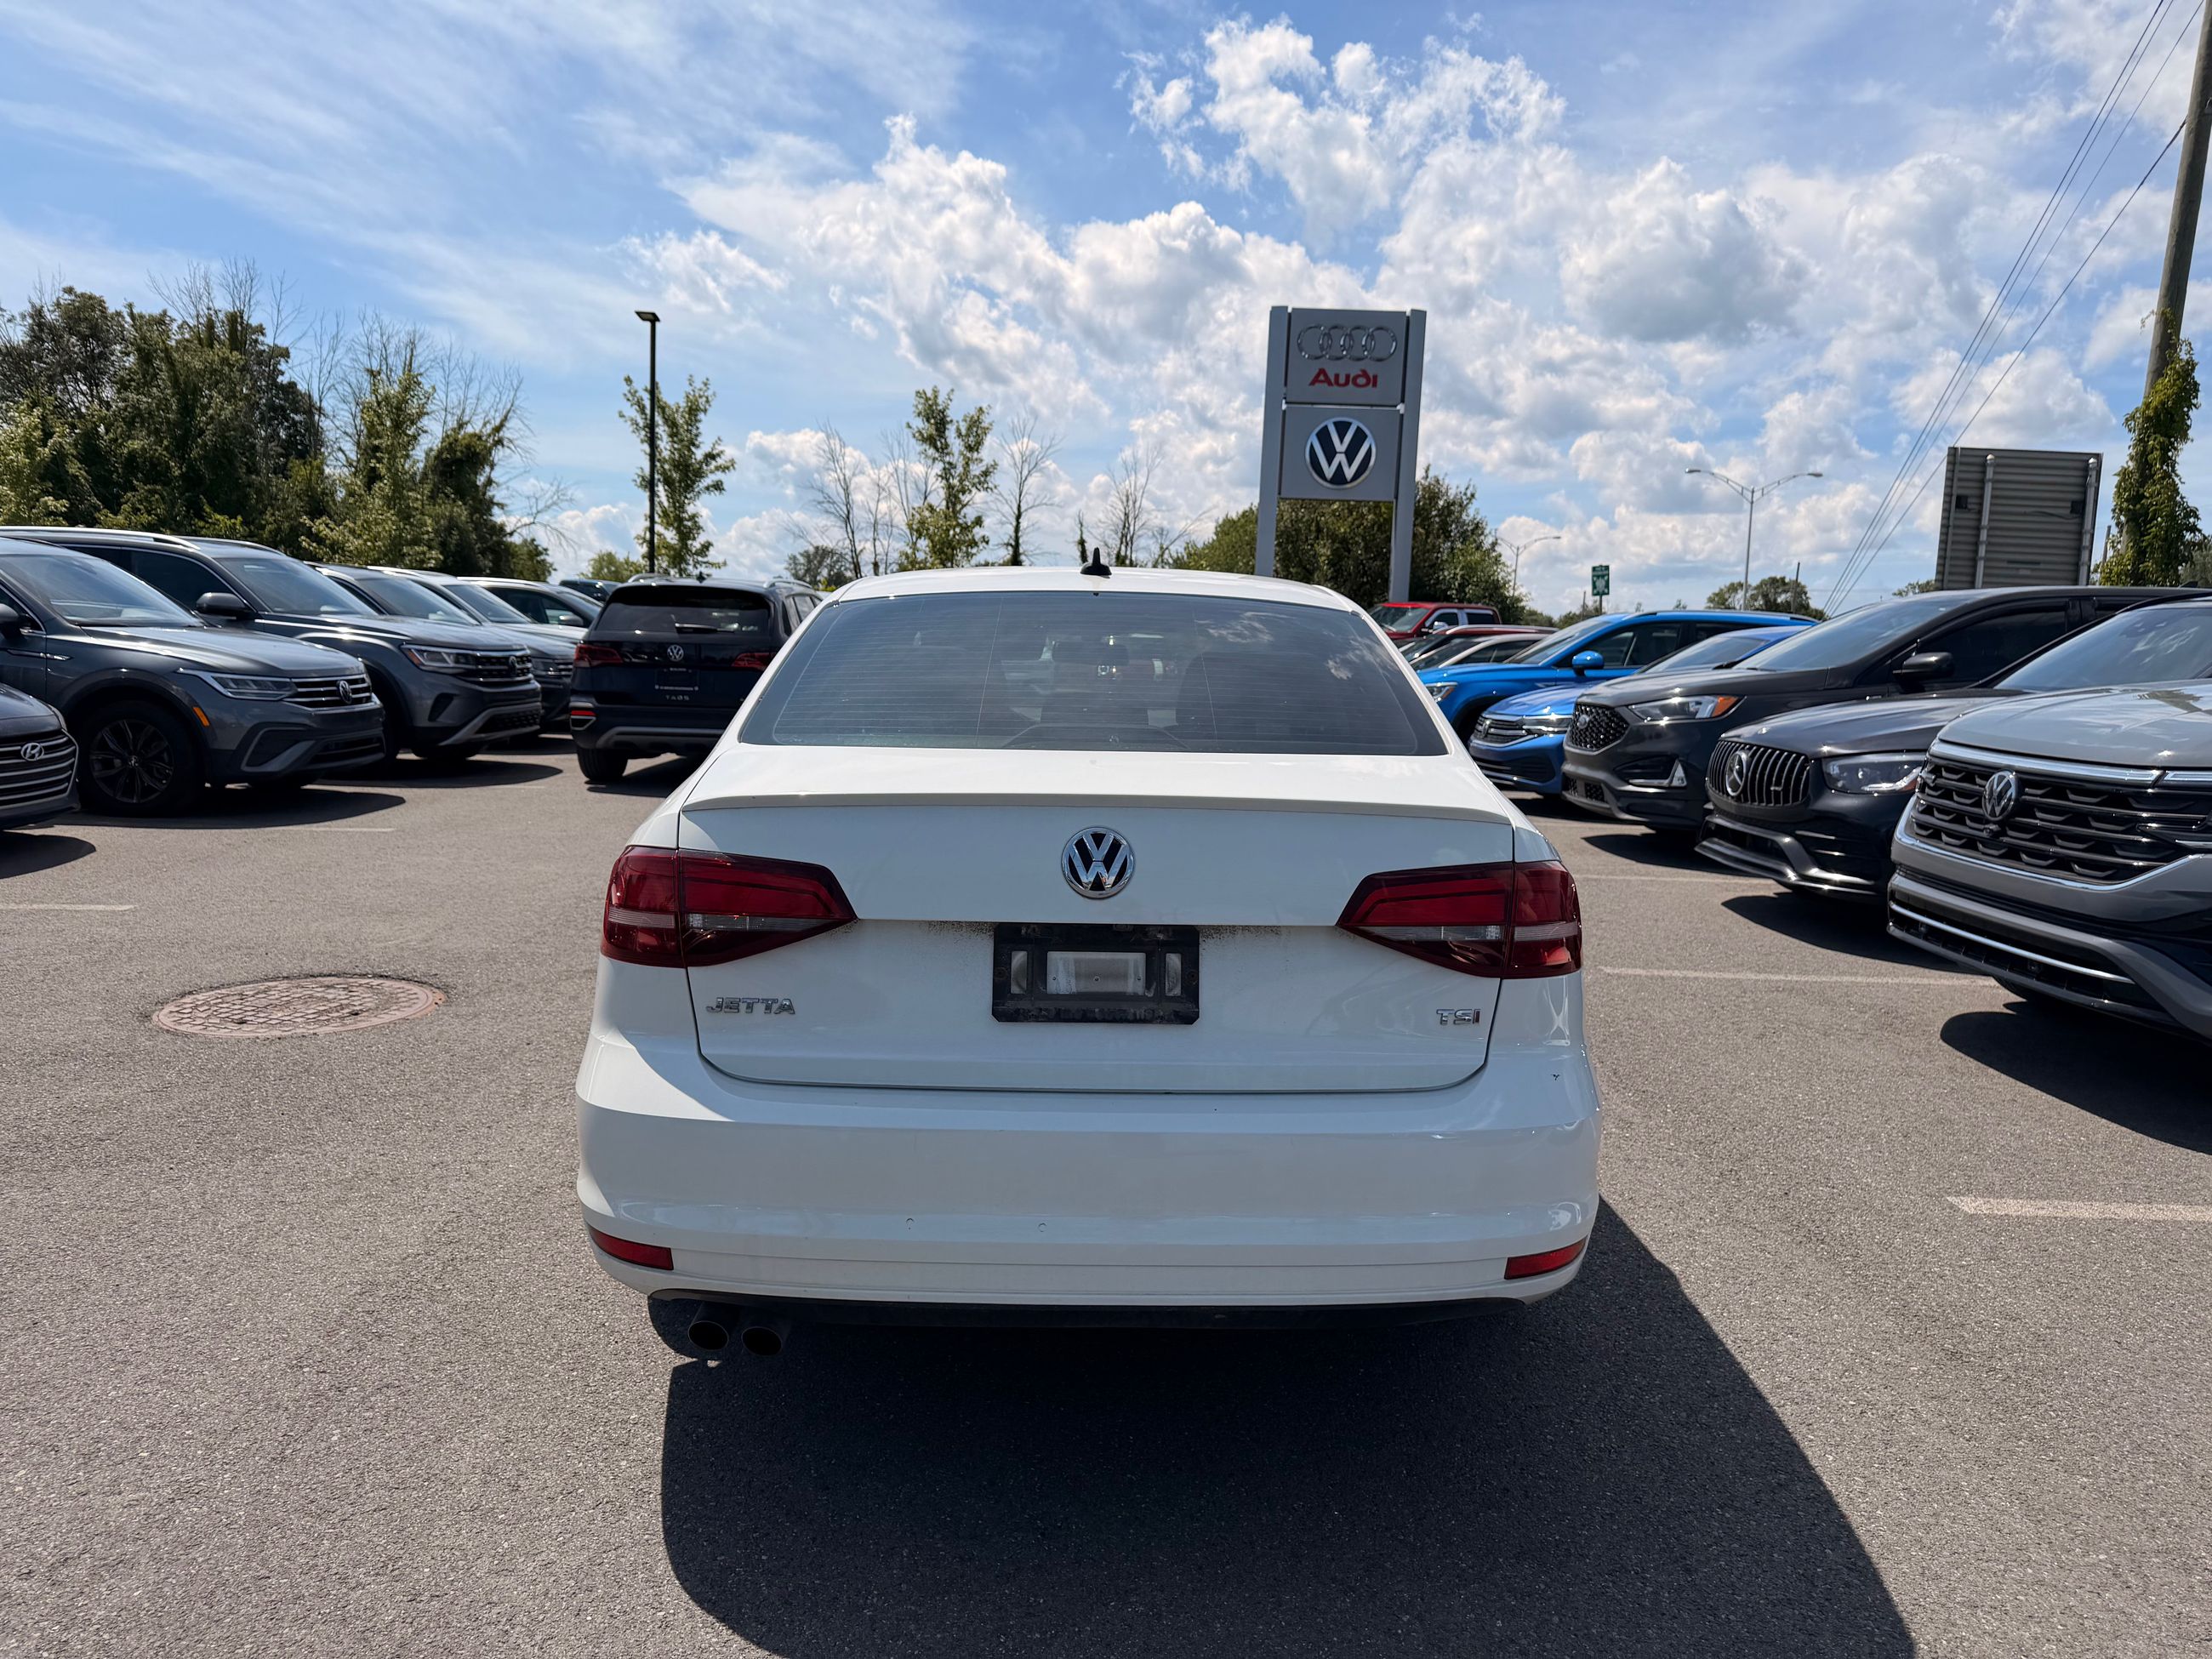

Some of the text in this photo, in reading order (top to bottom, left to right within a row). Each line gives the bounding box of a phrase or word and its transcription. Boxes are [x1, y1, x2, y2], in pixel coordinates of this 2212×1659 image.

[1309, 368, 1378, 388] Audi
[1306, 418, 1376, 489] VW
[1062, 827, 1135, 898] VW
[706, 997, 795, 1015] JETTA
[1436, 1008, 1481, 1025] TSI
